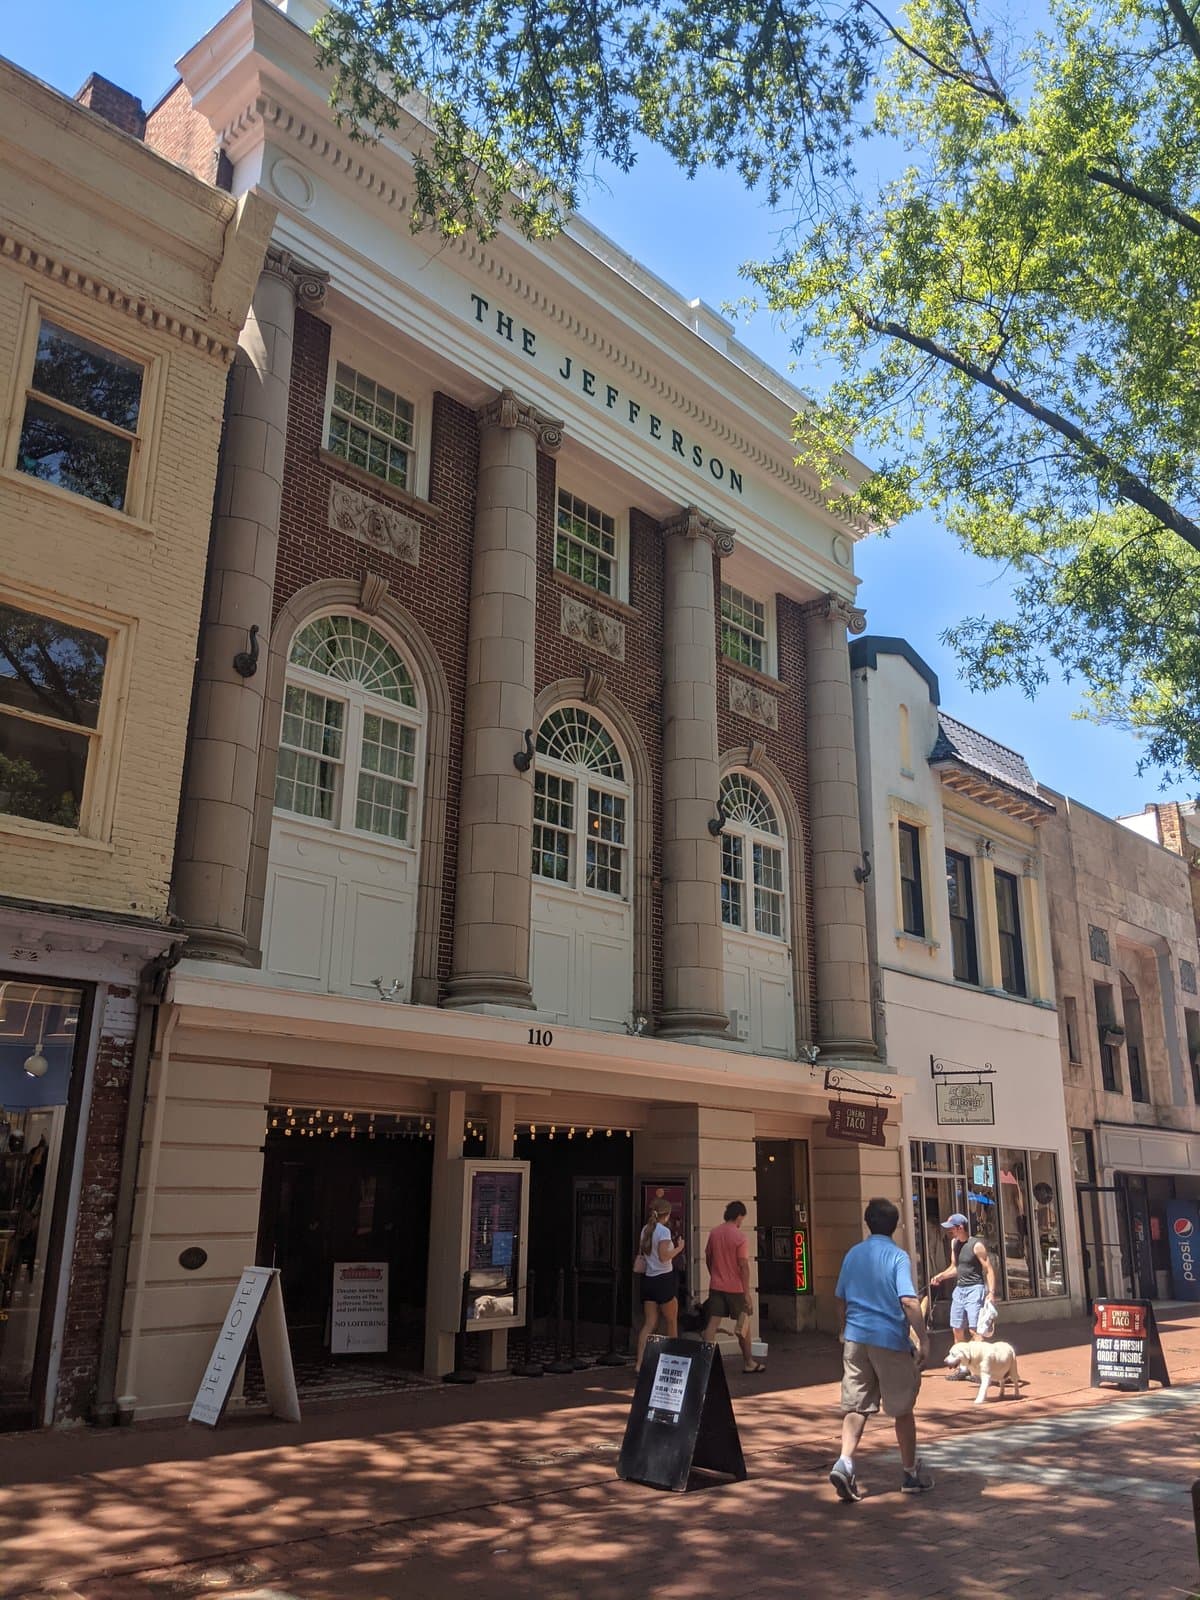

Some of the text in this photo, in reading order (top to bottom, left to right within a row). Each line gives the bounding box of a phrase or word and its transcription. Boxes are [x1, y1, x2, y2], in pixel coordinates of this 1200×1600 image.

[471, 293, 743, 494] THE JEFFERSON
[528, 1028, 553, 1047] 110
[847, 1109, 865, 1119] CINEMA
[847, 1117, 865, 1129] TACO
[795, 1233, 804, 1287] OPEN
[1179, 1242, 1196, 1281] pepsi
[1112, 1316, 1129, 1326] TACO
[205, 1352, 227, 1394] JEFF
[225, 1277, 257, 1341] HOTEL
[1097, 1339, 1143, 1352] FAST & FRESH!
[1097, 1351, 1144, 1364] ORDER INSIDE.
[659, 1375, 669, 1383] OPEN
[670, 1369, 683, 1377] OFFICE
